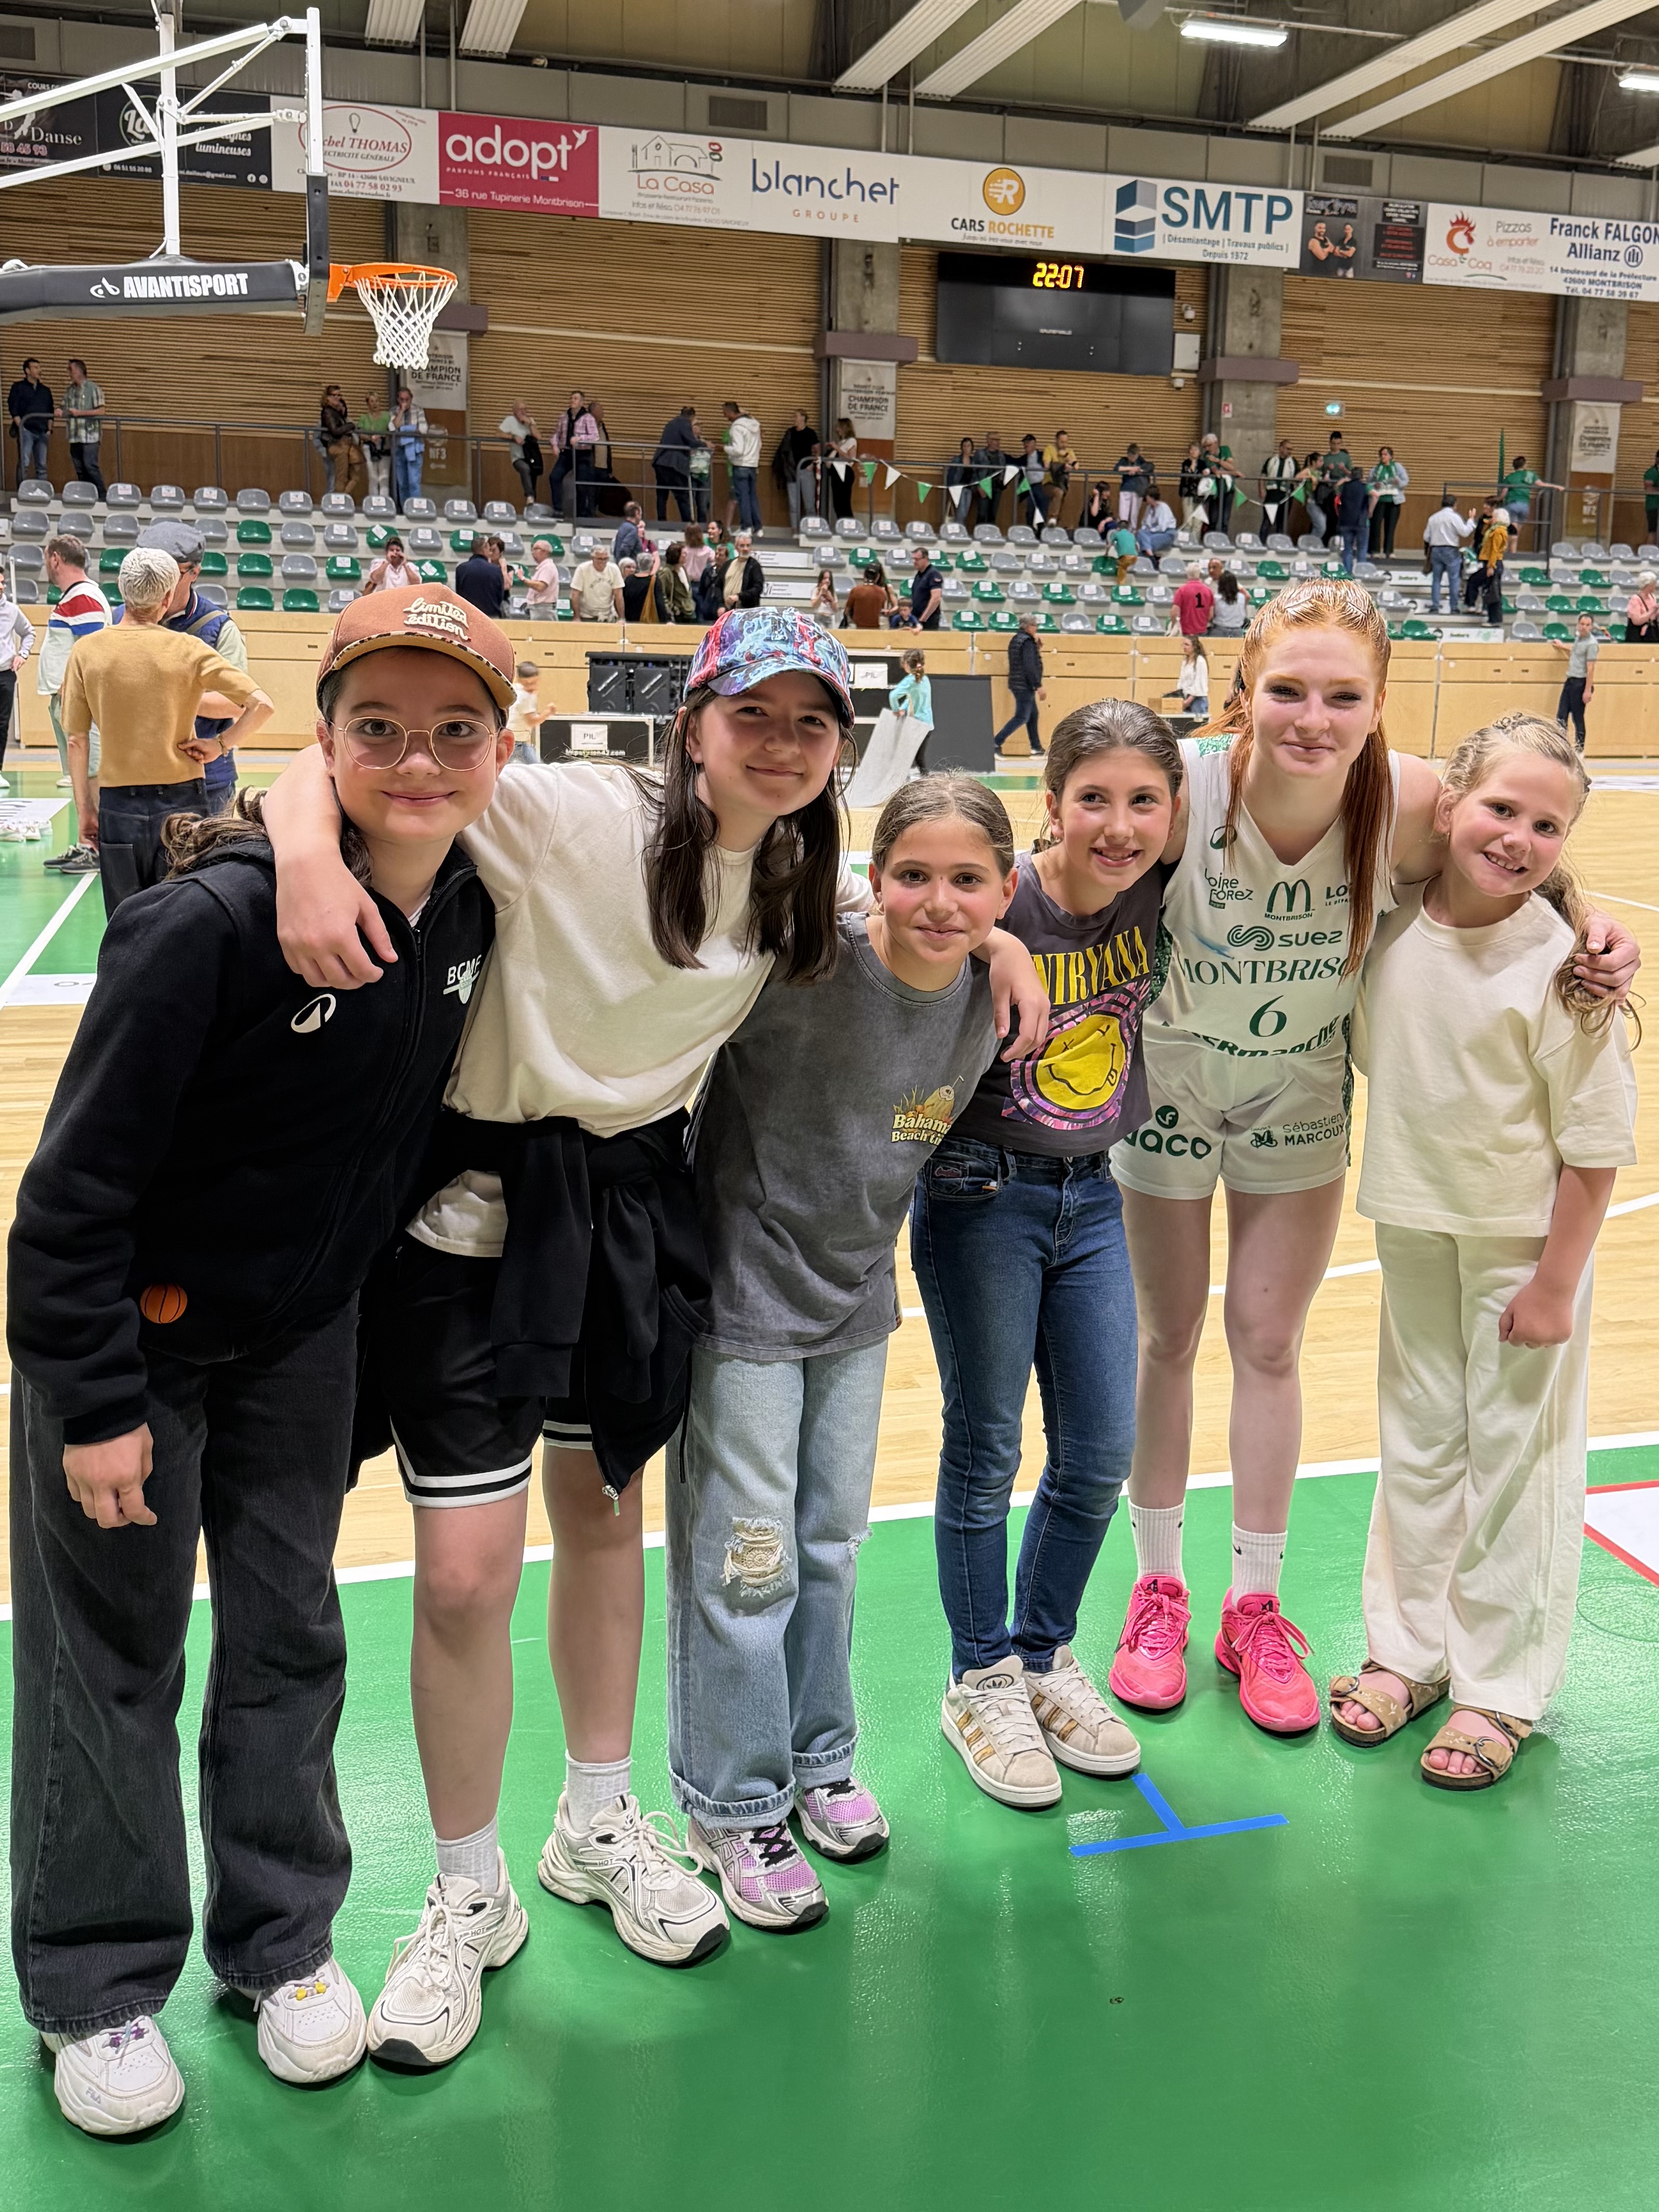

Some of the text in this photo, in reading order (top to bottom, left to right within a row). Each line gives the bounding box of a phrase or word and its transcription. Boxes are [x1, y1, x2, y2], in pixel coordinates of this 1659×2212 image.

[31, 126, 82, 146] Danse
[349, 137, 408, 154] THOMAS
[445, 124, 572, 180] adopt
[446, 167, 530, 180] PARFUMS FRANÇAIS
[752, 158, 900, 205] blanchet
[368, 182, 378, 190] 58
[380, 183, 390, 192] 02
[637, 174, 714, 195] La Casa
[471, 191, 488, 200] rue
[490, 190, 531, 204] Tupinerie
[533, 195, 585, 209] Montbrison
[792, 209, 859, 223] GROUPE
[1162, 186, 1293, 235] SMTP
[951, 218, 1055, 238] CARS ROCHETTE
[1496, 220, 1533, 233] Pizzas
[1550, 217, 1600, 240] Franck
[1227, 238, 1256, 249] Travaux
[1257, 240, 1284, 252] publics
[1496, 237, 1539, 247] emporter
[1202, 249, 1249, 261] Depuis 1972
[1566, 242, 1620, 262] Allianz
[1427, 254, 1458, 268] Casa
[1032, 262, 1084, 289] 22:07
[1560, 267, 1598, 277] boulevard
[123, 273, 248, 298] AVANTISPORT
[1588, 277, 1642, 290] MONTBRISON
[426, 373, 462, 382] FRANCE
[848, 395, 889, 404] CHAMPION
[859, 403, 888, 413] FRANCE
[1195, 592, 1205, 608] 1
[1264, 911, 1313, 922] MONTBRISON
[1278, 930, 1343, 948] suez
[1031, 925, 1150, 1006] NIRVANA
[1249, 994, 1287, 1038] 6
[1282, 1113, 1344, 1134] Sébastien
[891, 1129, 928, 1142] Beach
[1284, 1123, 1345, 1146] MARCOUX
[598, 1858, 614, 1866] HOT
[471, 1926, 486, 1937] HOT
